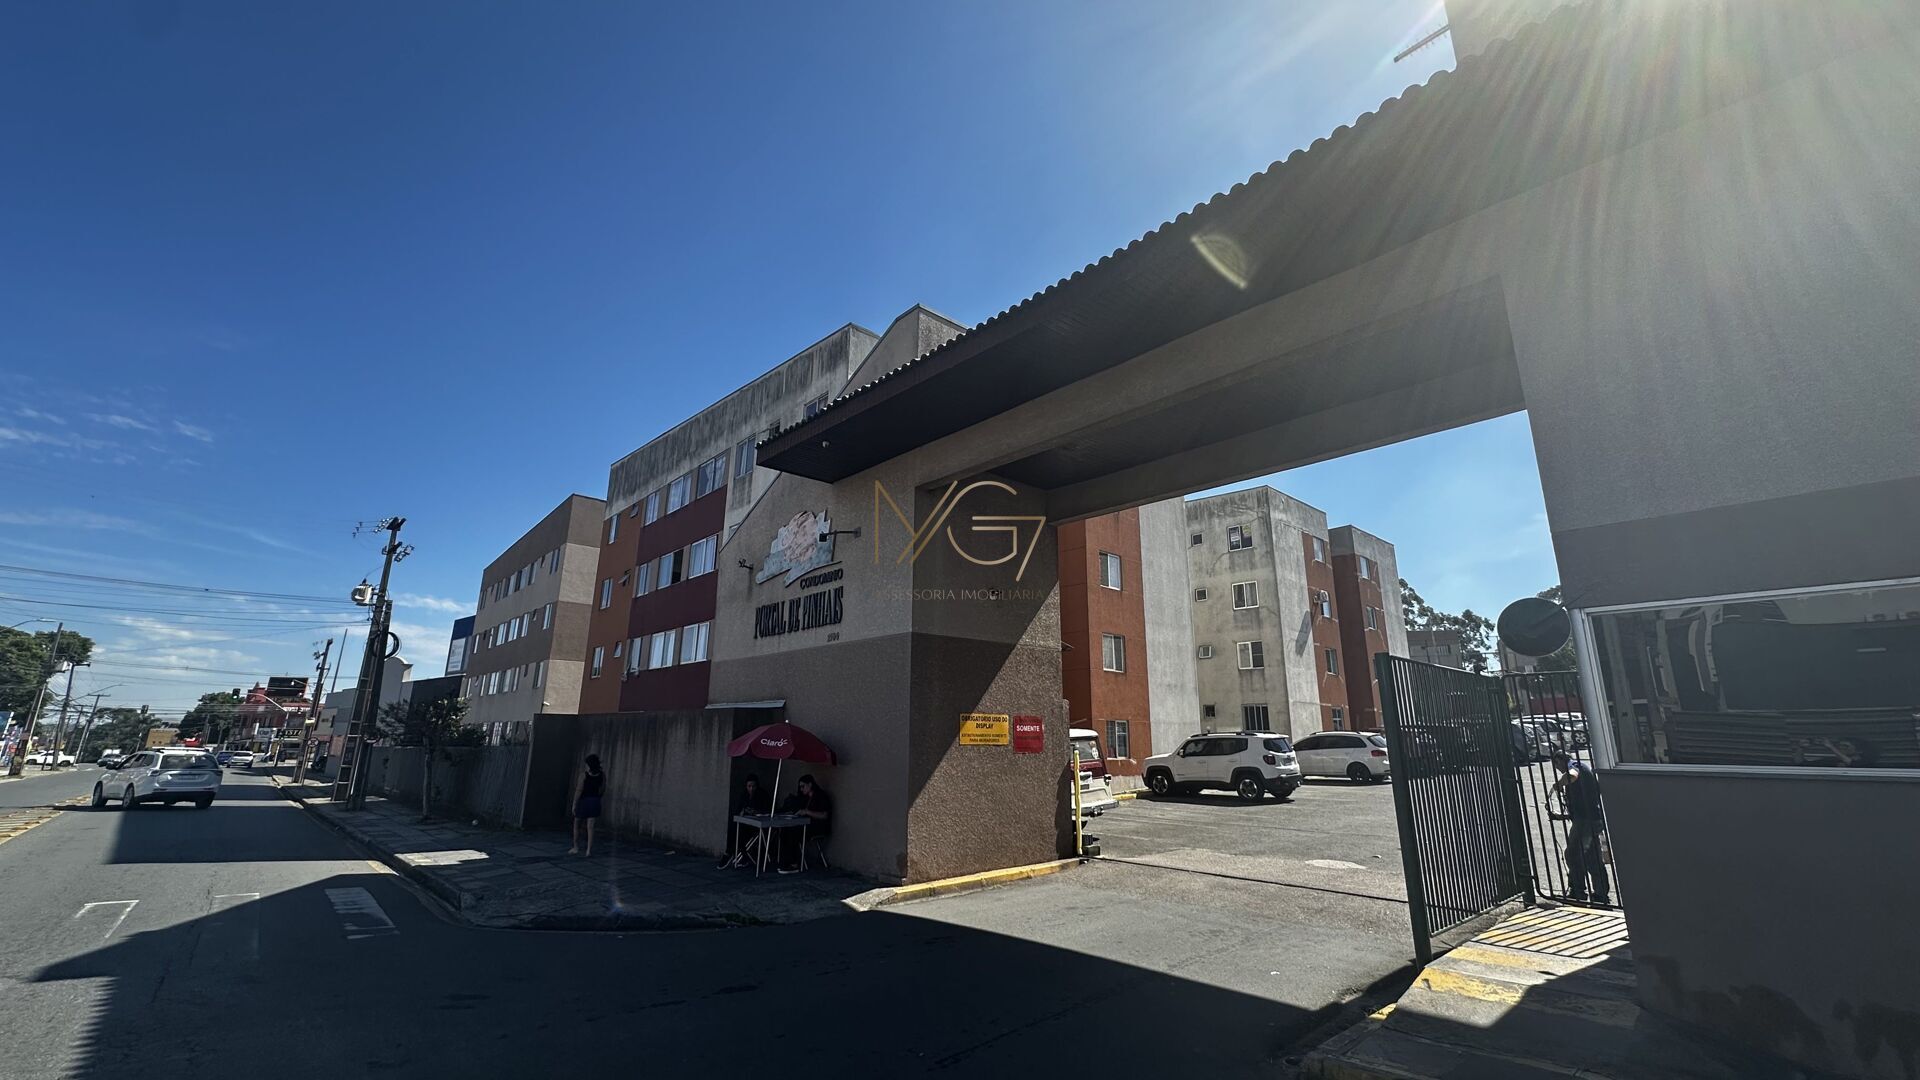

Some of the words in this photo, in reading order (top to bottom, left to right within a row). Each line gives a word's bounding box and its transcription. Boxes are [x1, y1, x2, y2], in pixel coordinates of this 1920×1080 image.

[754, 601, 786, 639] PORTAL
[787, 597, 801, 633] DE
[801, 586, 843, 630] PINHAIS
[760, 738, 785, 747] Claro
